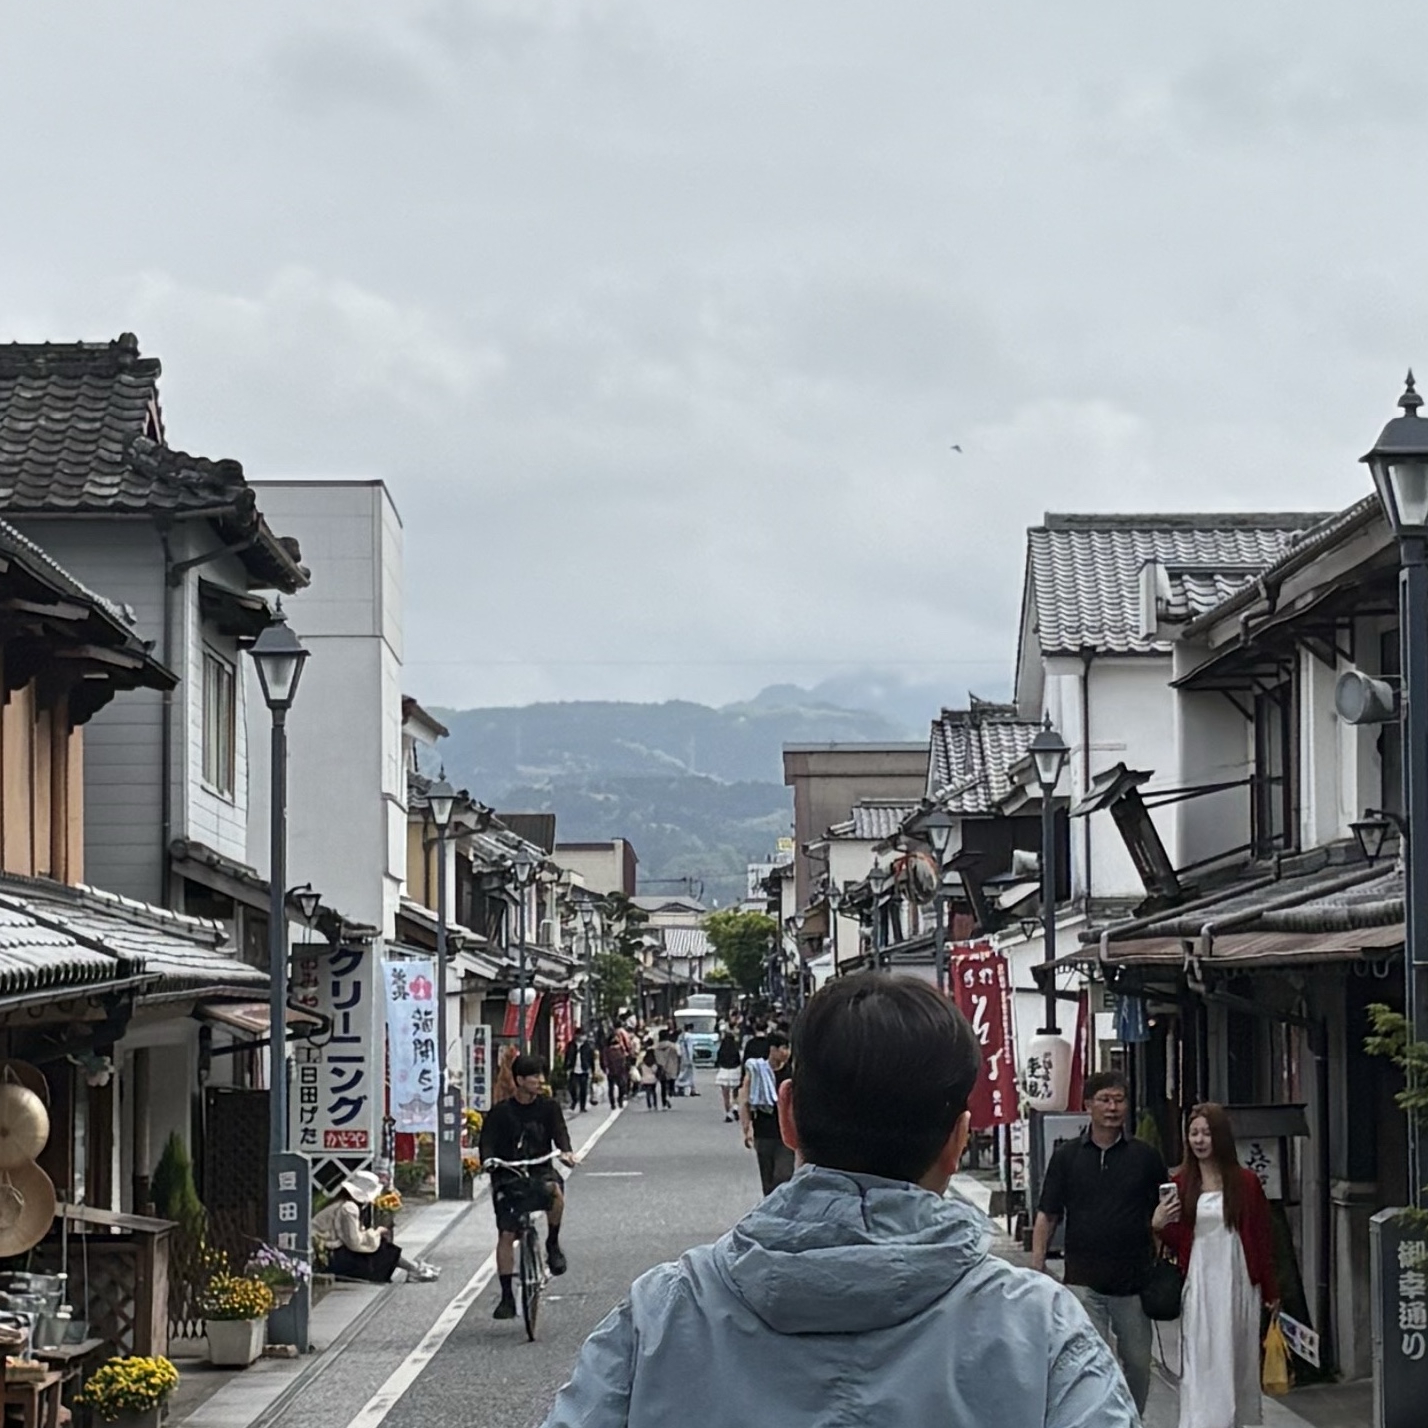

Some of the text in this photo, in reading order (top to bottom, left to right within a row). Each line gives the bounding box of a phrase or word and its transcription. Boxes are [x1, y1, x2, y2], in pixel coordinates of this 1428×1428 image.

[327, 948, 368, 1126] クリーニング
[300, 1066, 319, 1145] 日田げた
[1398, 1240, 1427, 1360] 御幸通り
